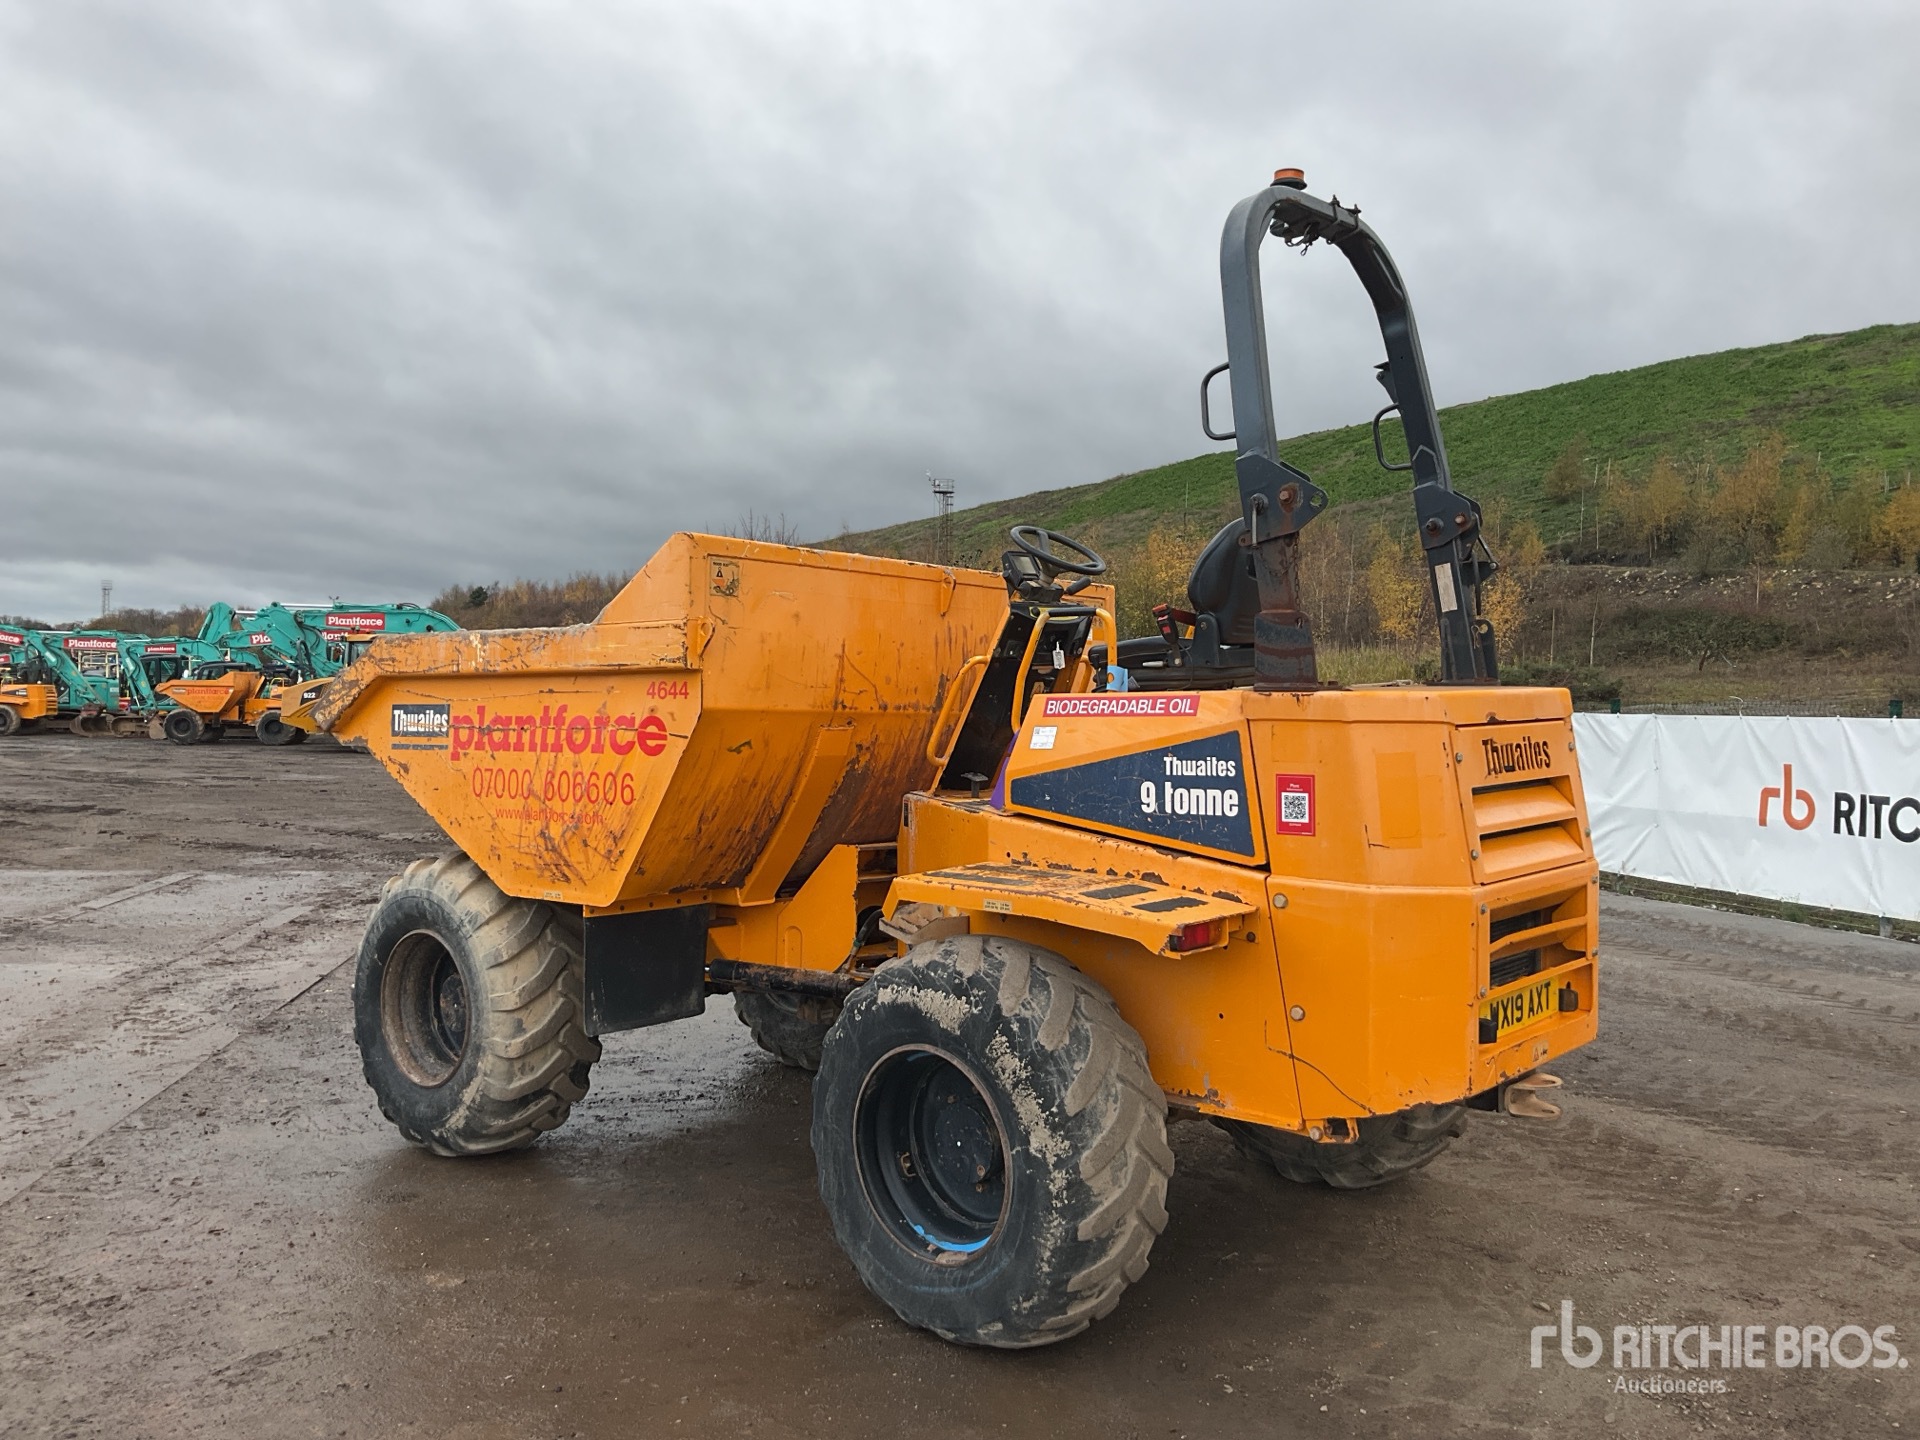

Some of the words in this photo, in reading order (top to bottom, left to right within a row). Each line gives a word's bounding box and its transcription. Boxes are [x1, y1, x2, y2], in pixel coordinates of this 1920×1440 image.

[328, 616, 384, 627] Plantforce
[68, 639, 117, 649] Plantforce
[646, 680, 690, 700] 4644
[1046, 698, 1166, 715] BIODEGRADABLE
[1169, 696, 1195, 714] OIL
[393, 709, 449, 732] Thwaites
[450, 704, 668, 762] plantforce
[1163, 756, 1236, 777] Thwaites
[1481, 735, 1551, 776] Thwaites
[472, 765, 533, 801] 07000
[543, 768, 635, 806] 606606
[1140, 781, 1156, 814] 9
[1164, 781, 1239, 817] tonne
[1758, 764, 1816, 831] rb
[1528, 981, 1551, 1019] AXT
